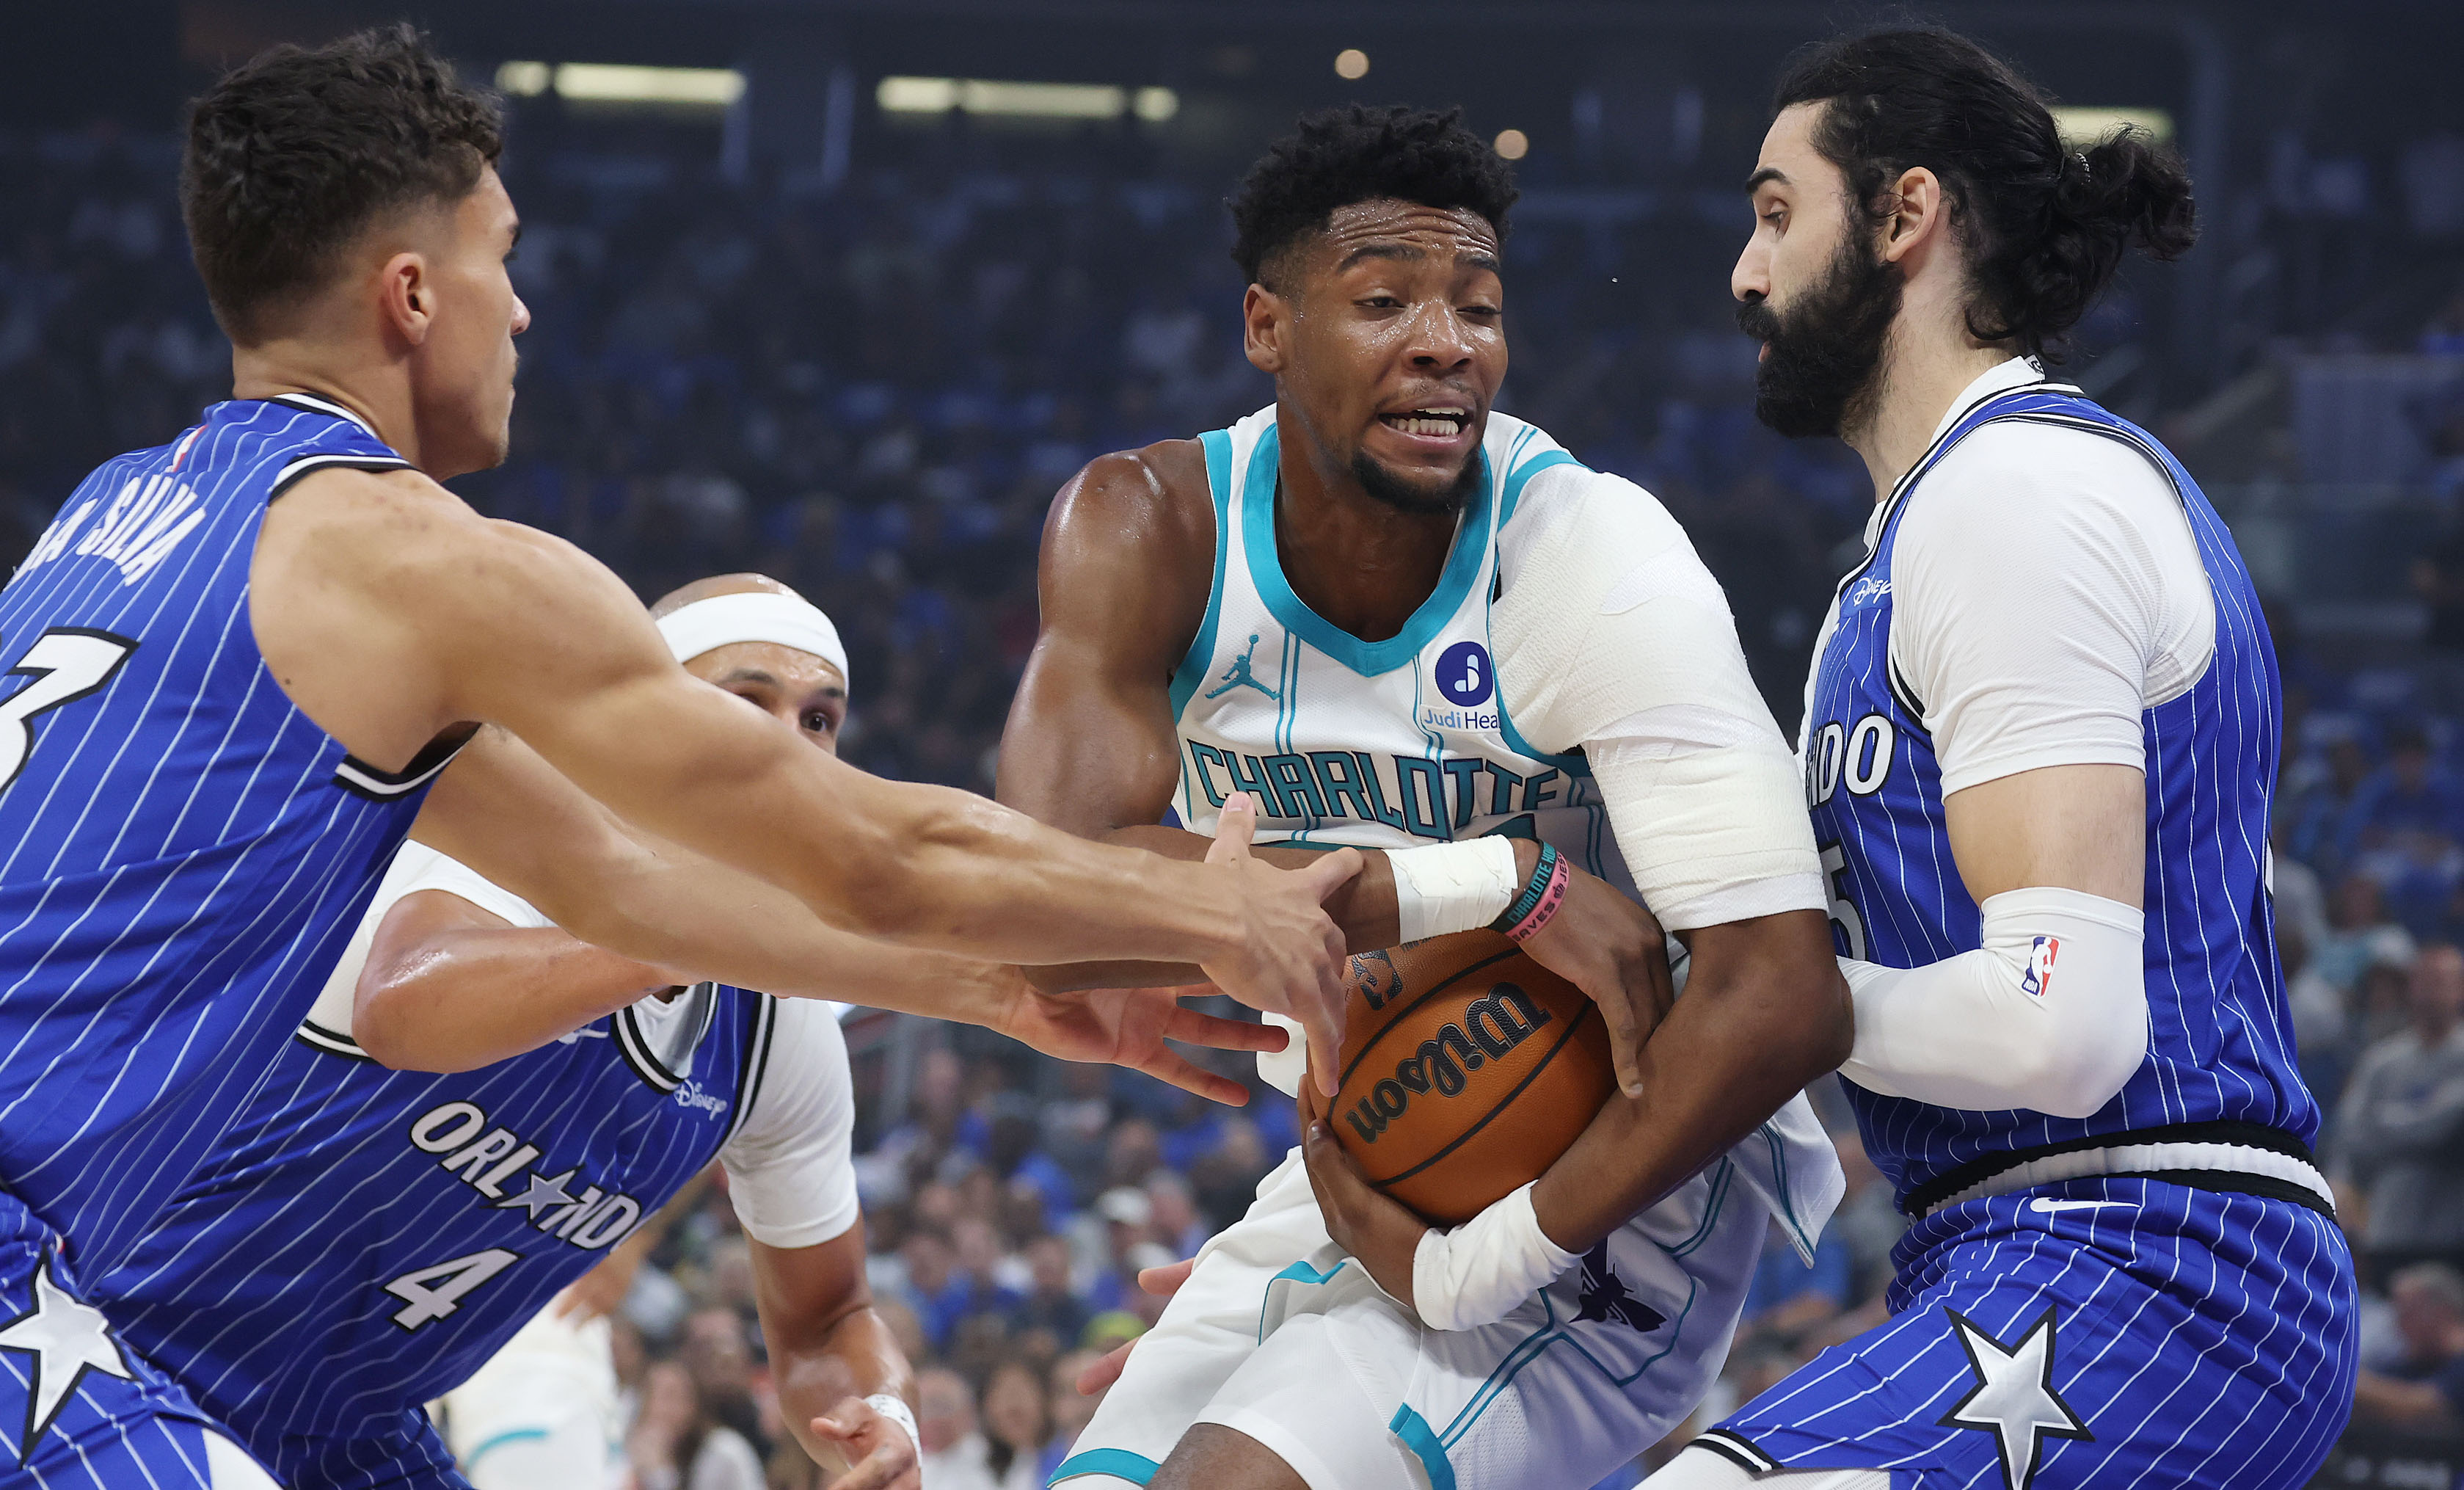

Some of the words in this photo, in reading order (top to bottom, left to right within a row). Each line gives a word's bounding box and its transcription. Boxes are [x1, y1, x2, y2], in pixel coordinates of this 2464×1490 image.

[76, 474, 206, 586] SILVA
[1425, 709, 1462, 729] Judi
[1465, 711, 1498, 729] Hea
[1187, 738, 1559, 842] CHARLOTTE
[1506, 862, 1553, 924] CHARLOTTE
[1556, 854, 1567, 882] JES
[2023, 978, 2038, 993] NBA
[1344, 981, 1553, 1144] Wilson
[380, 1247, 525, 1334] 4
